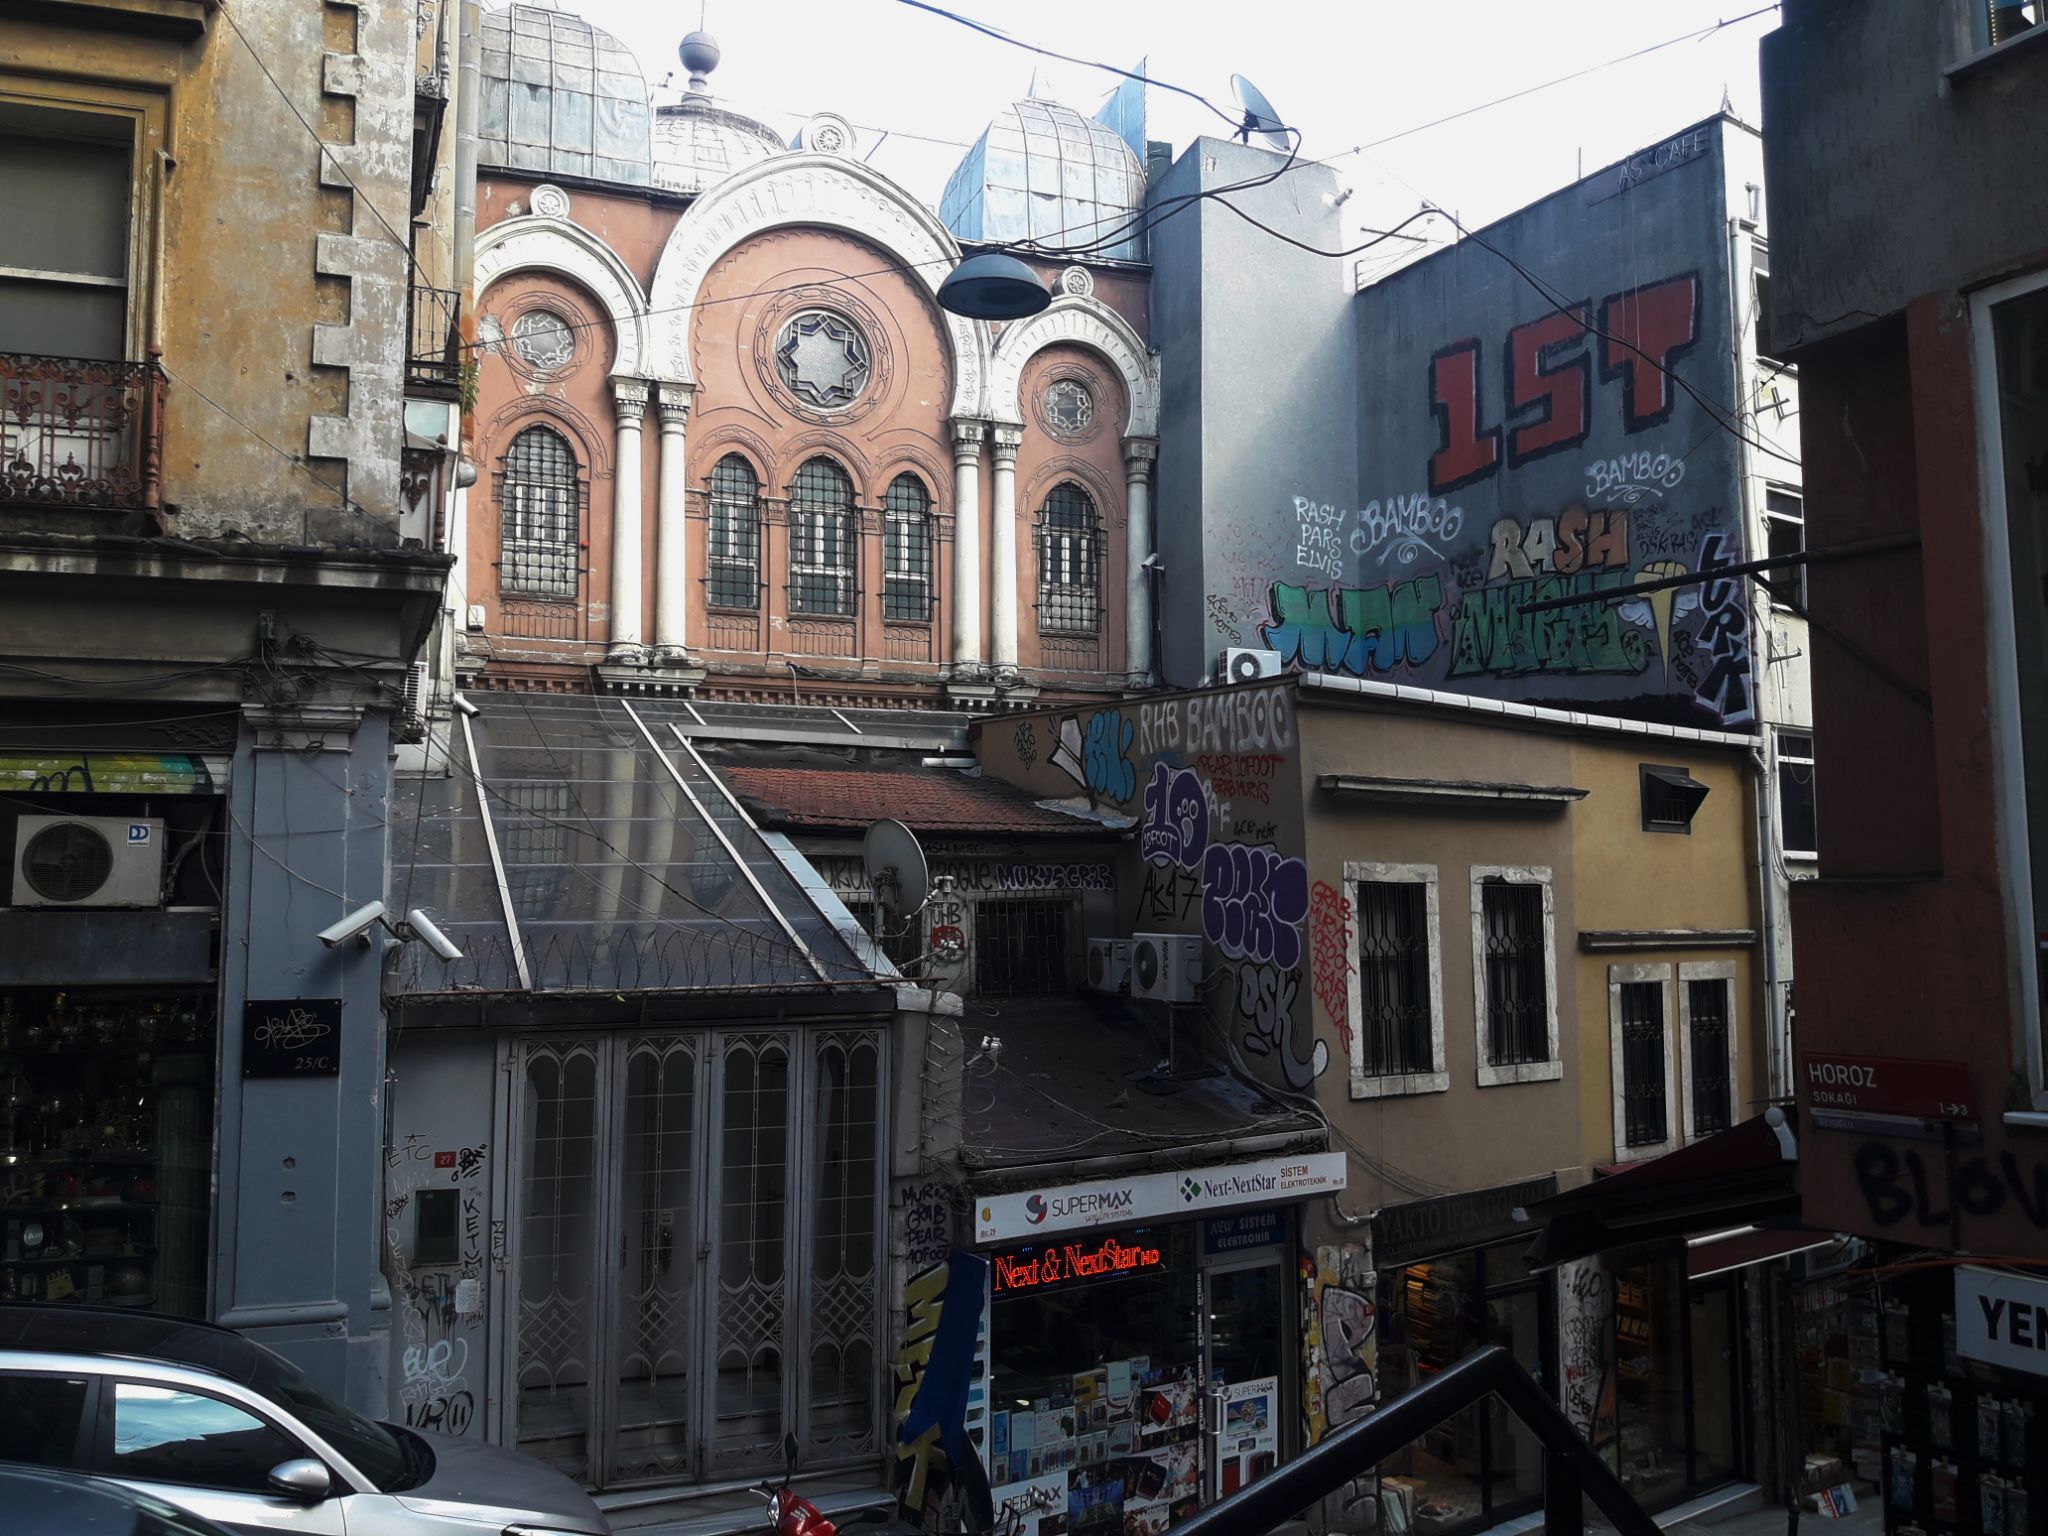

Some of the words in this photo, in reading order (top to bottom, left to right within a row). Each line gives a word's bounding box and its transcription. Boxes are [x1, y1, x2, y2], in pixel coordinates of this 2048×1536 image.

[1586, 451, 1685, 498] BAMBOO
[1292, 495, 1347, 531] RASH
[1351, 491, 1464, 553] BAMBOO
[1302, 523, 1342, 561] PARS
[1484, 506, 1632, 585] RASH
[1296, 545, 1343, 580] ELVIS
[1140, 700, 1182, 754] RHB
[1187, 686, 1294, 752] BAMBOO
[295, 1057, 330, 1070] 25/C
[1808, 1063, 1877, 1088] HOROZ
[440, 1155, 451, 1165] 27
[1280, 1165, 1309, 1178] SİSTEM
[1280, 1176, 1328, 1190] ELEKTROTEKNİK
[1052, 1190, 1133, 1217] SUPERMAX
[904, 1227, 948, 1247] PEAR
[1211, 1219, 1234, 1236] NEW
[1239, 1212, 1277, 1231] SİSTEM
[994, 1255, 1039, 1291] Next
[1041, 1247, 1062, 1283] &
[993, 1485, 1042, 1516] UPERAX
